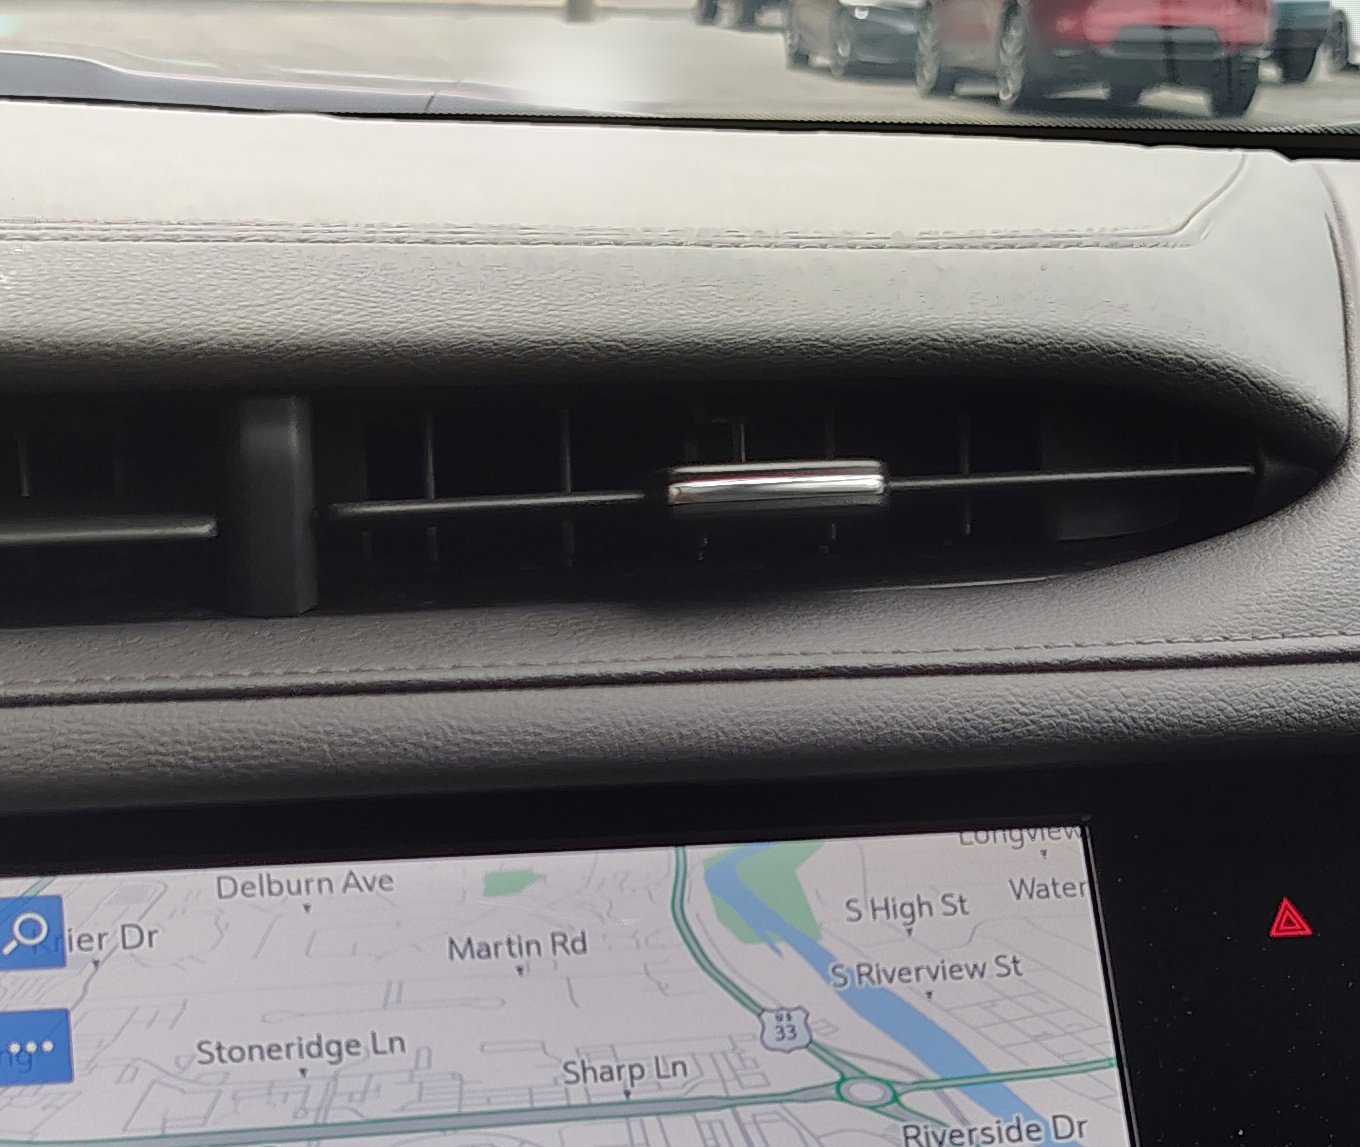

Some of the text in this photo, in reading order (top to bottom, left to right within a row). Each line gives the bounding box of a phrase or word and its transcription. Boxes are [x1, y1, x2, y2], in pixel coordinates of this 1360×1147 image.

[216, 871, 394, 900] Delburn Ave
[1009, 877, 1087, 900] Water
[845, 893, 969, 926] S High St
[121, 924, 159, 950] Dr
[448, 931, 587, 961] Martin Rd
[831, 955, 1024, 988] S Riverview St
[775, 1023, 797, 1042] 33
[196, 1032, 406, 1067] Stoneridge Ln
[562, 1054, 688, 1085] Sharp Ln
[1052, 1115, 1088, 1141] Dr
